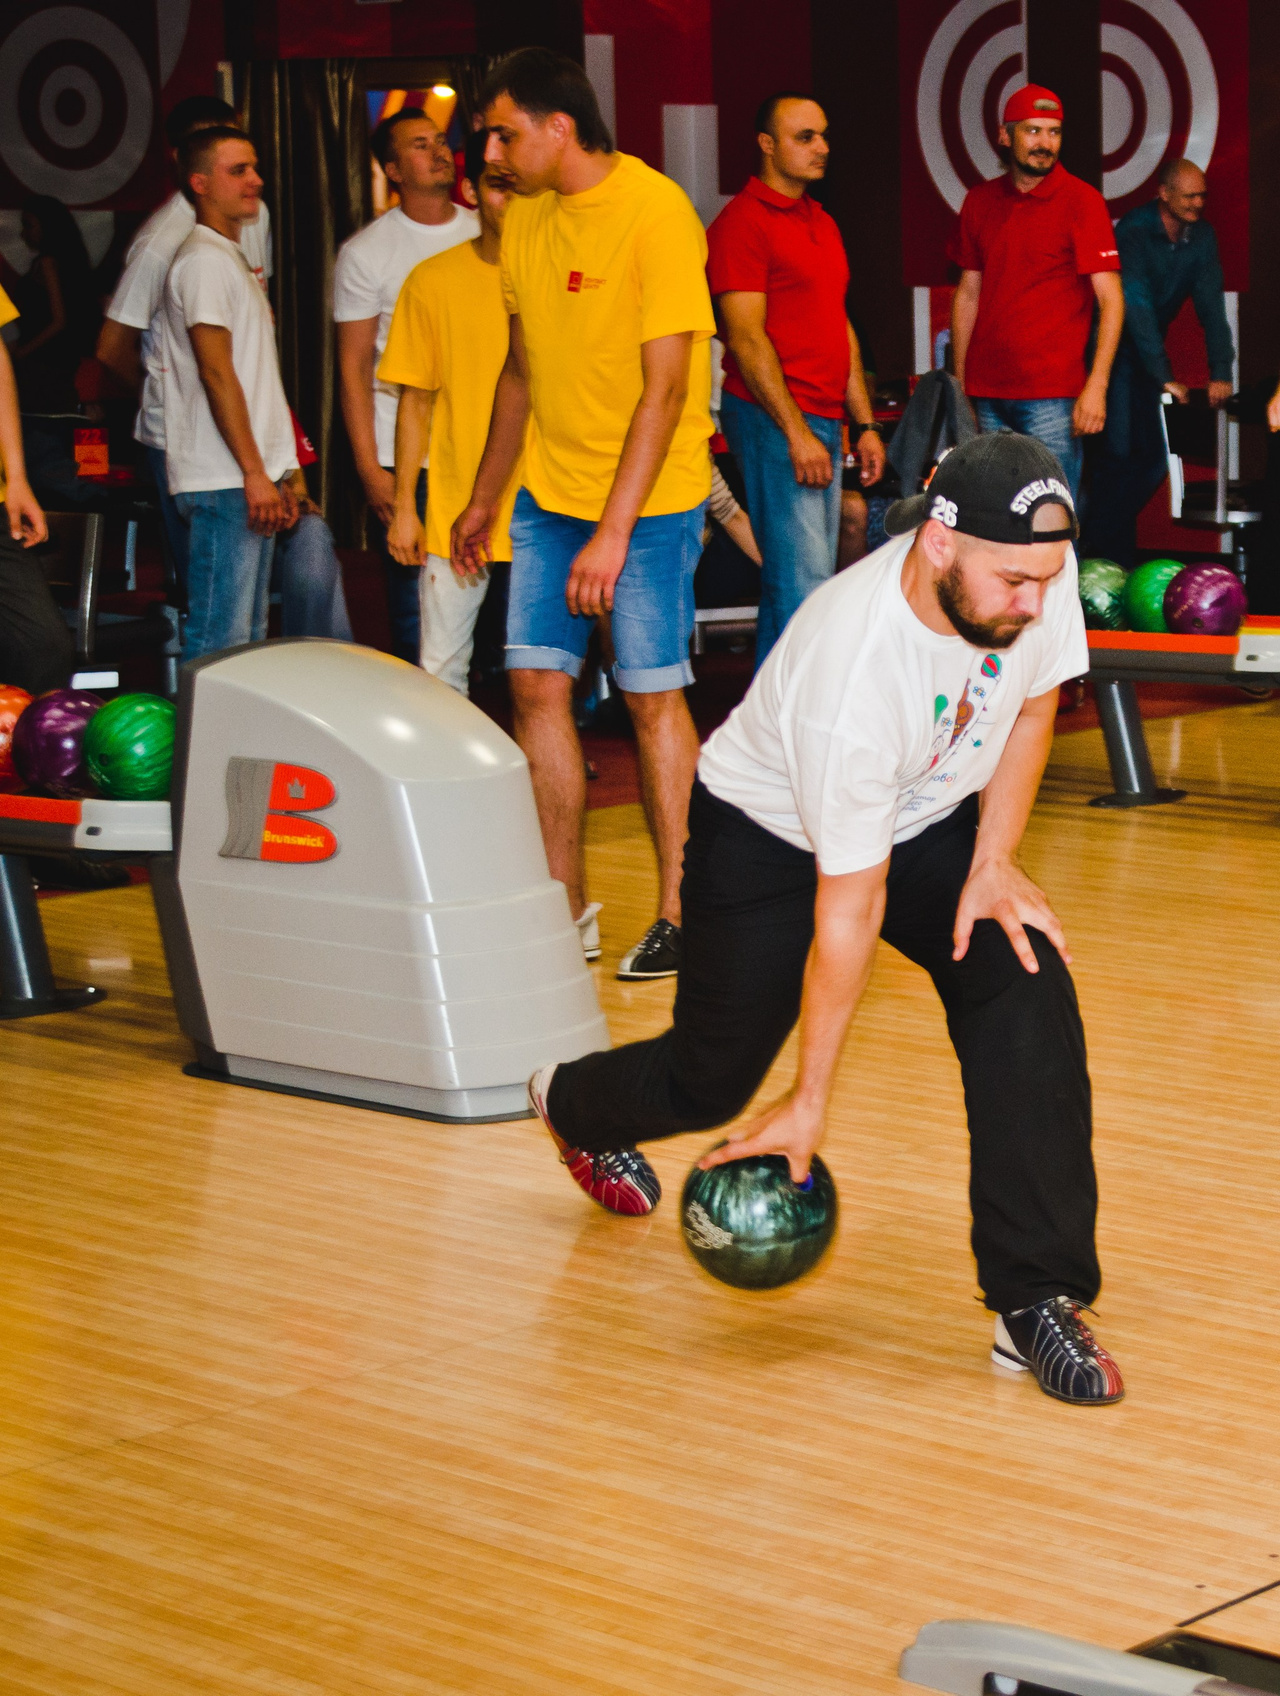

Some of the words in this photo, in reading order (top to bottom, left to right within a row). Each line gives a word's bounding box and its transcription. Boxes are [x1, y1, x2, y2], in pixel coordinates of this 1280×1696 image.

[81, 428, 101, 445] 22
[931, 495, 958, 528] 26
[263, 830, 324, 848] Brunswick
